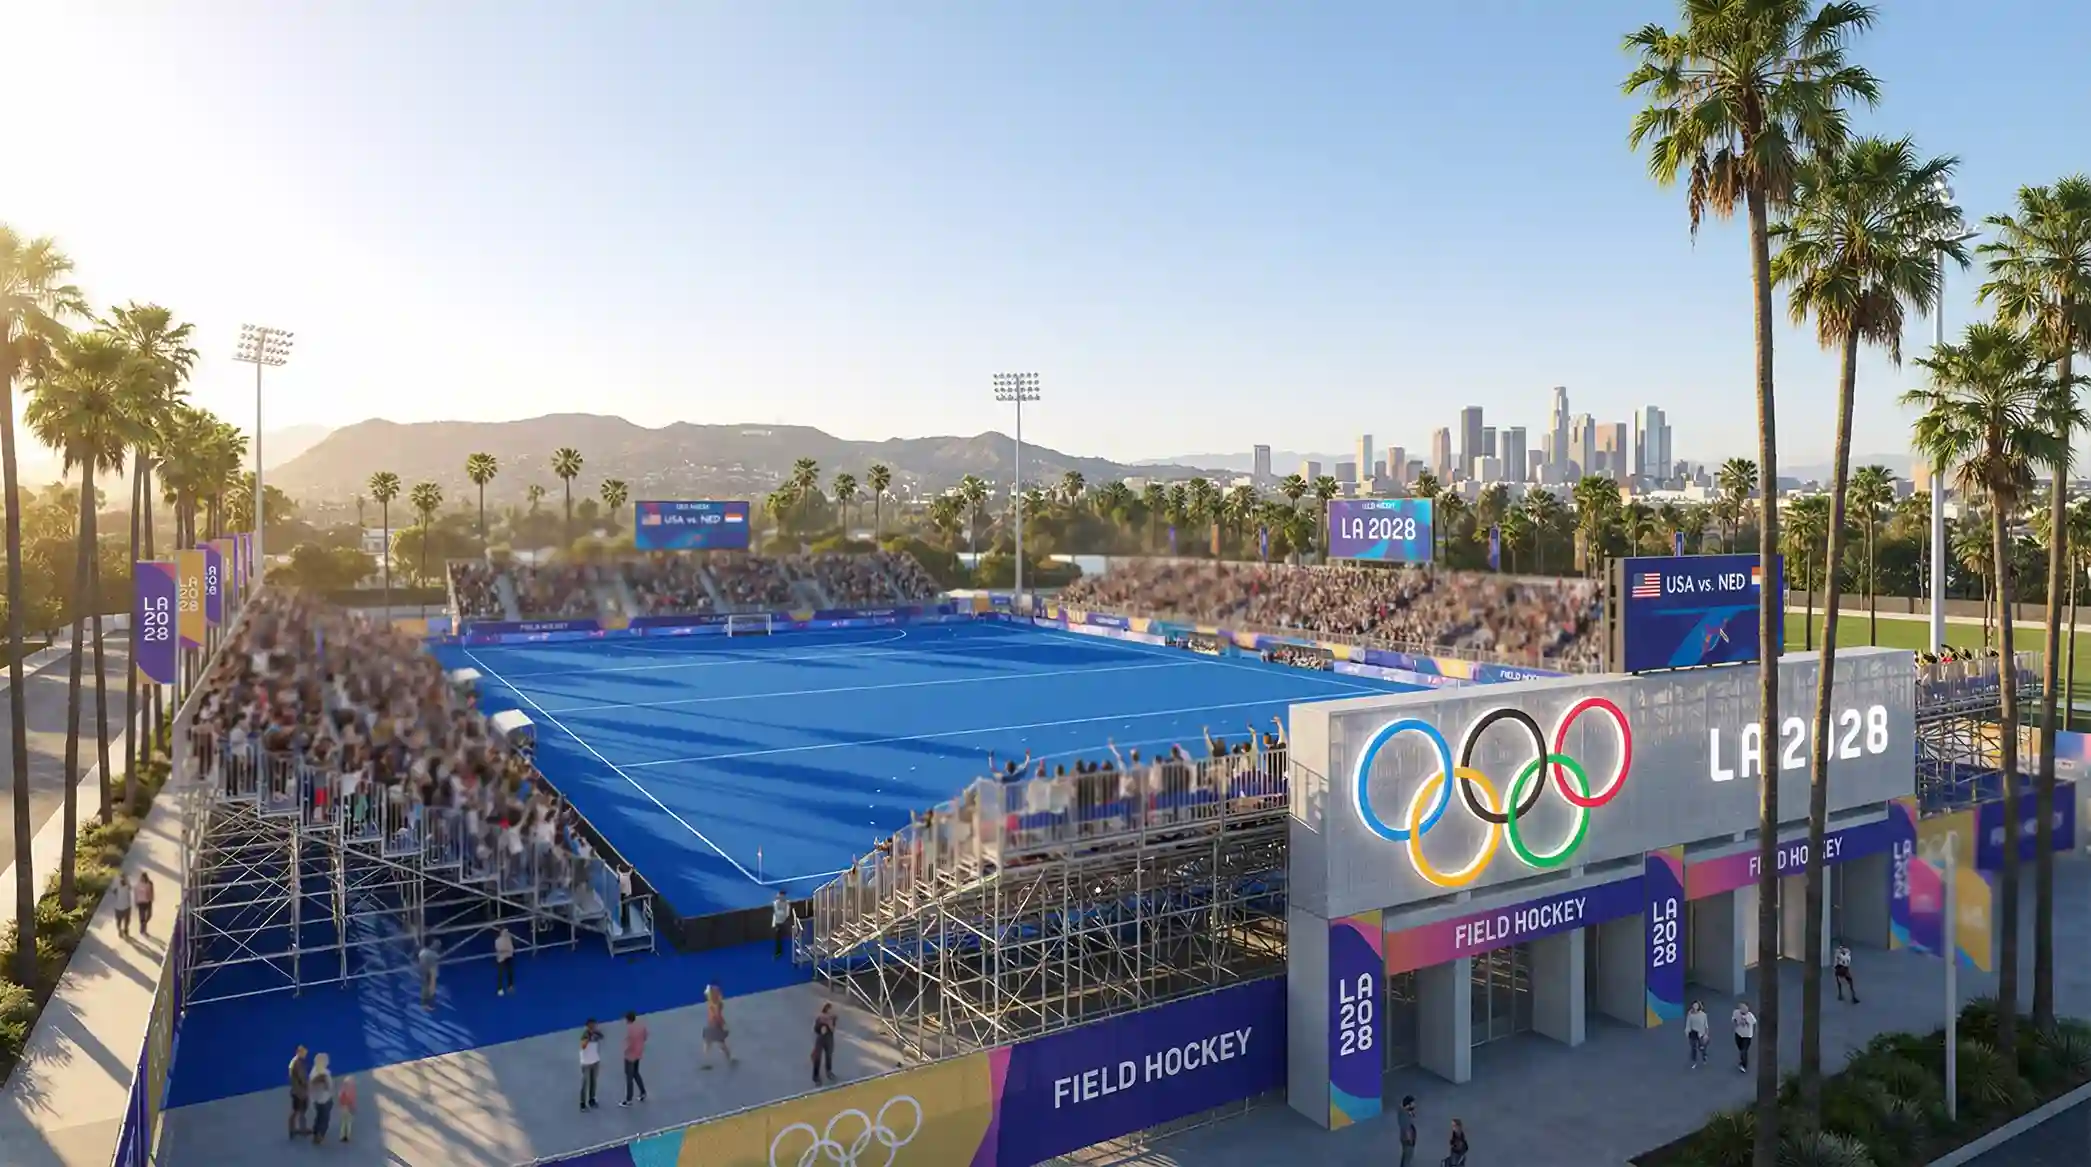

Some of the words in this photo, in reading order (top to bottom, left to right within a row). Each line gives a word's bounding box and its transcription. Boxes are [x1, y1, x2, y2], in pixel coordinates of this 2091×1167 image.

[1341, 517, 1364, 539] LA
[1368, 517, 1416, 540] 2028
[179, 588, 199, 599] 20
[1666, 575, 1695, 593] USA
[1698, 578, 1714, 592] vs.
[1718, 573, 1746, 591] NED
[144, 596, 168, 611] LA
[179, 600, 199, 612] 28
[144, 612, 169, 626] 20
[144, 627, 169, 641] 28
[1710, 722, 1762, 782] LA
[1749, 850, 1787, 877] FID
[1790, 836, 1843, 867] HOEY
[1455, 915, 1510, 949] FIELD
[1515, 896, 1587, 934] HOCKEY
[1653, 897, 1677, 923] LA
[1653, 920, 1677, 946] 20
[1653, 942, 1677, 968] 28
[1340, 972, 1373, 1004] LA
[1340, 999, 1373, 1030] 20
[1340, 1024, 1373, 1056] 28
[1054, 1060, 1137, 1109] FIELD
[1145, 1026, 1252, 1083] HOCKEY
